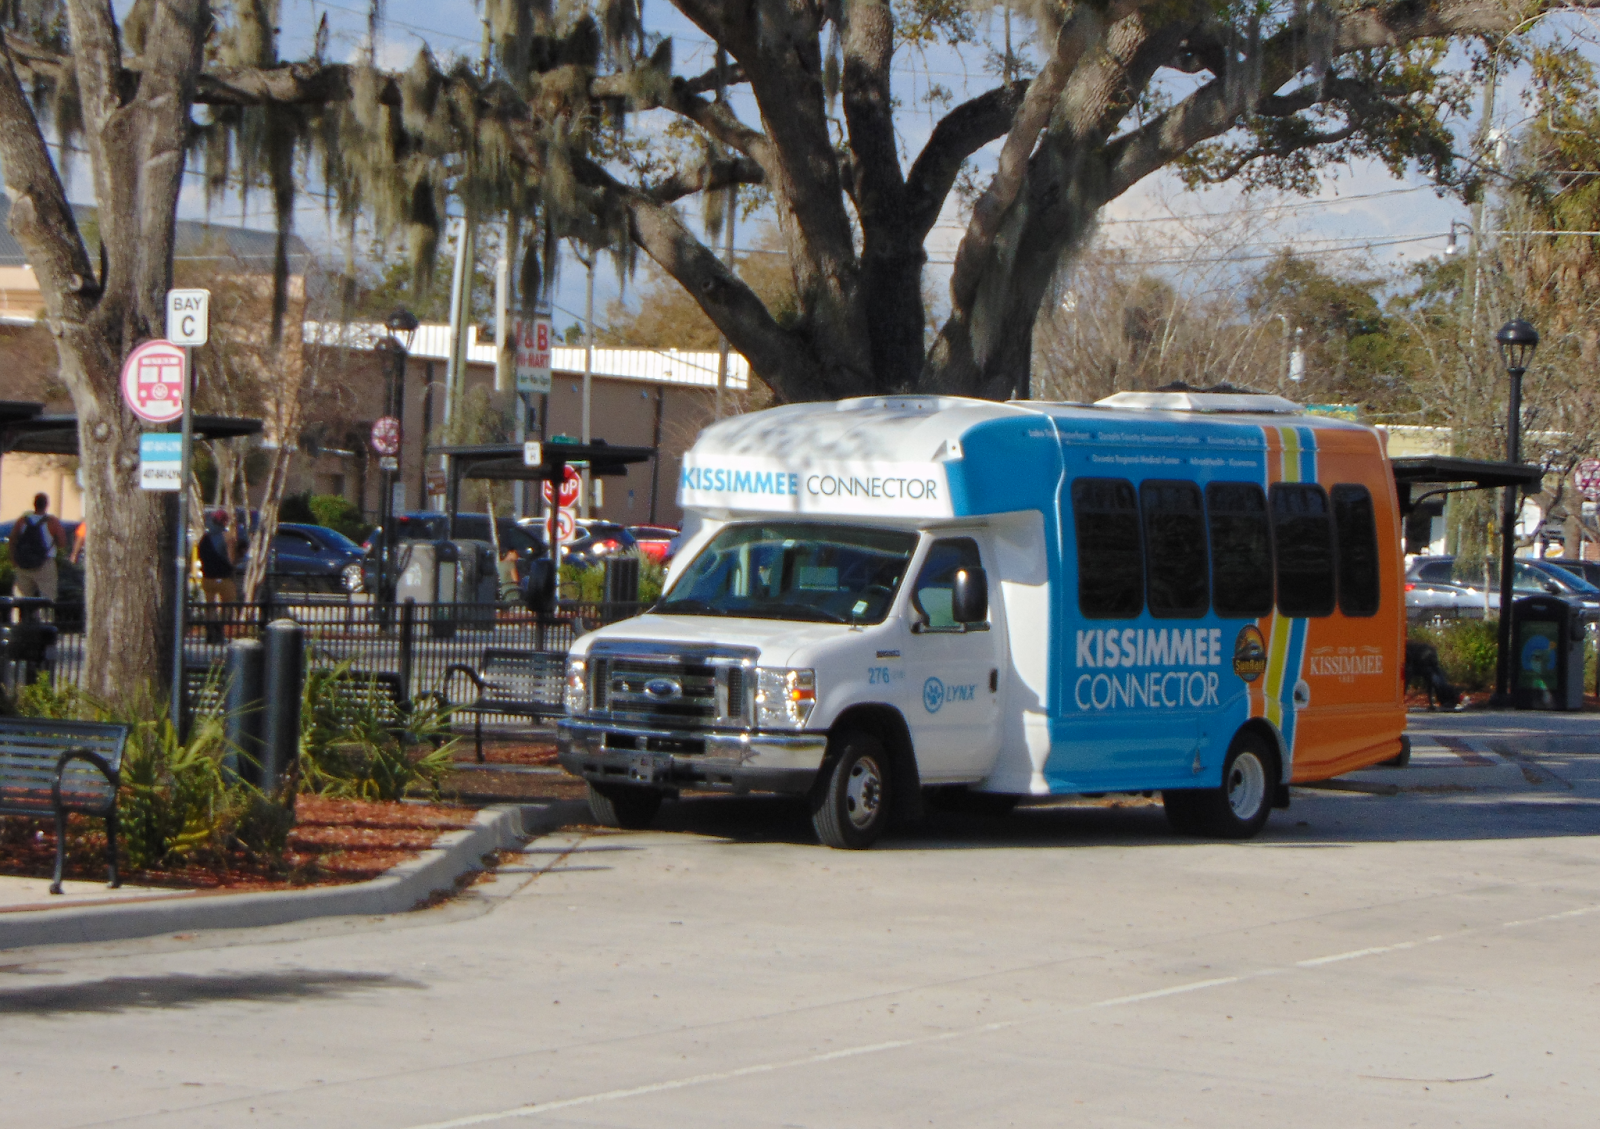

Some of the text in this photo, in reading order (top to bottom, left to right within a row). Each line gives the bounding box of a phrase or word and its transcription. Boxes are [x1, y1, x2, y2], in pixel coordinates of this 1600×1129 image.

[174, 297, 203, 311] BAY
[181, 316, 195, 337] C
[545, 479, 578, 495] SOP
[681, 467, 937, 500] KISSIMMEE CONNECTOR
[1076, 628, 1221, 667] KISSIMMEE
[1310, 655, 1384, 675] KISSIMMEE
[868, 667, 890, 684] 276
[946, 684, 977, 702] LYNX
[1075, 671, 1220, 710] CONNECTOR
